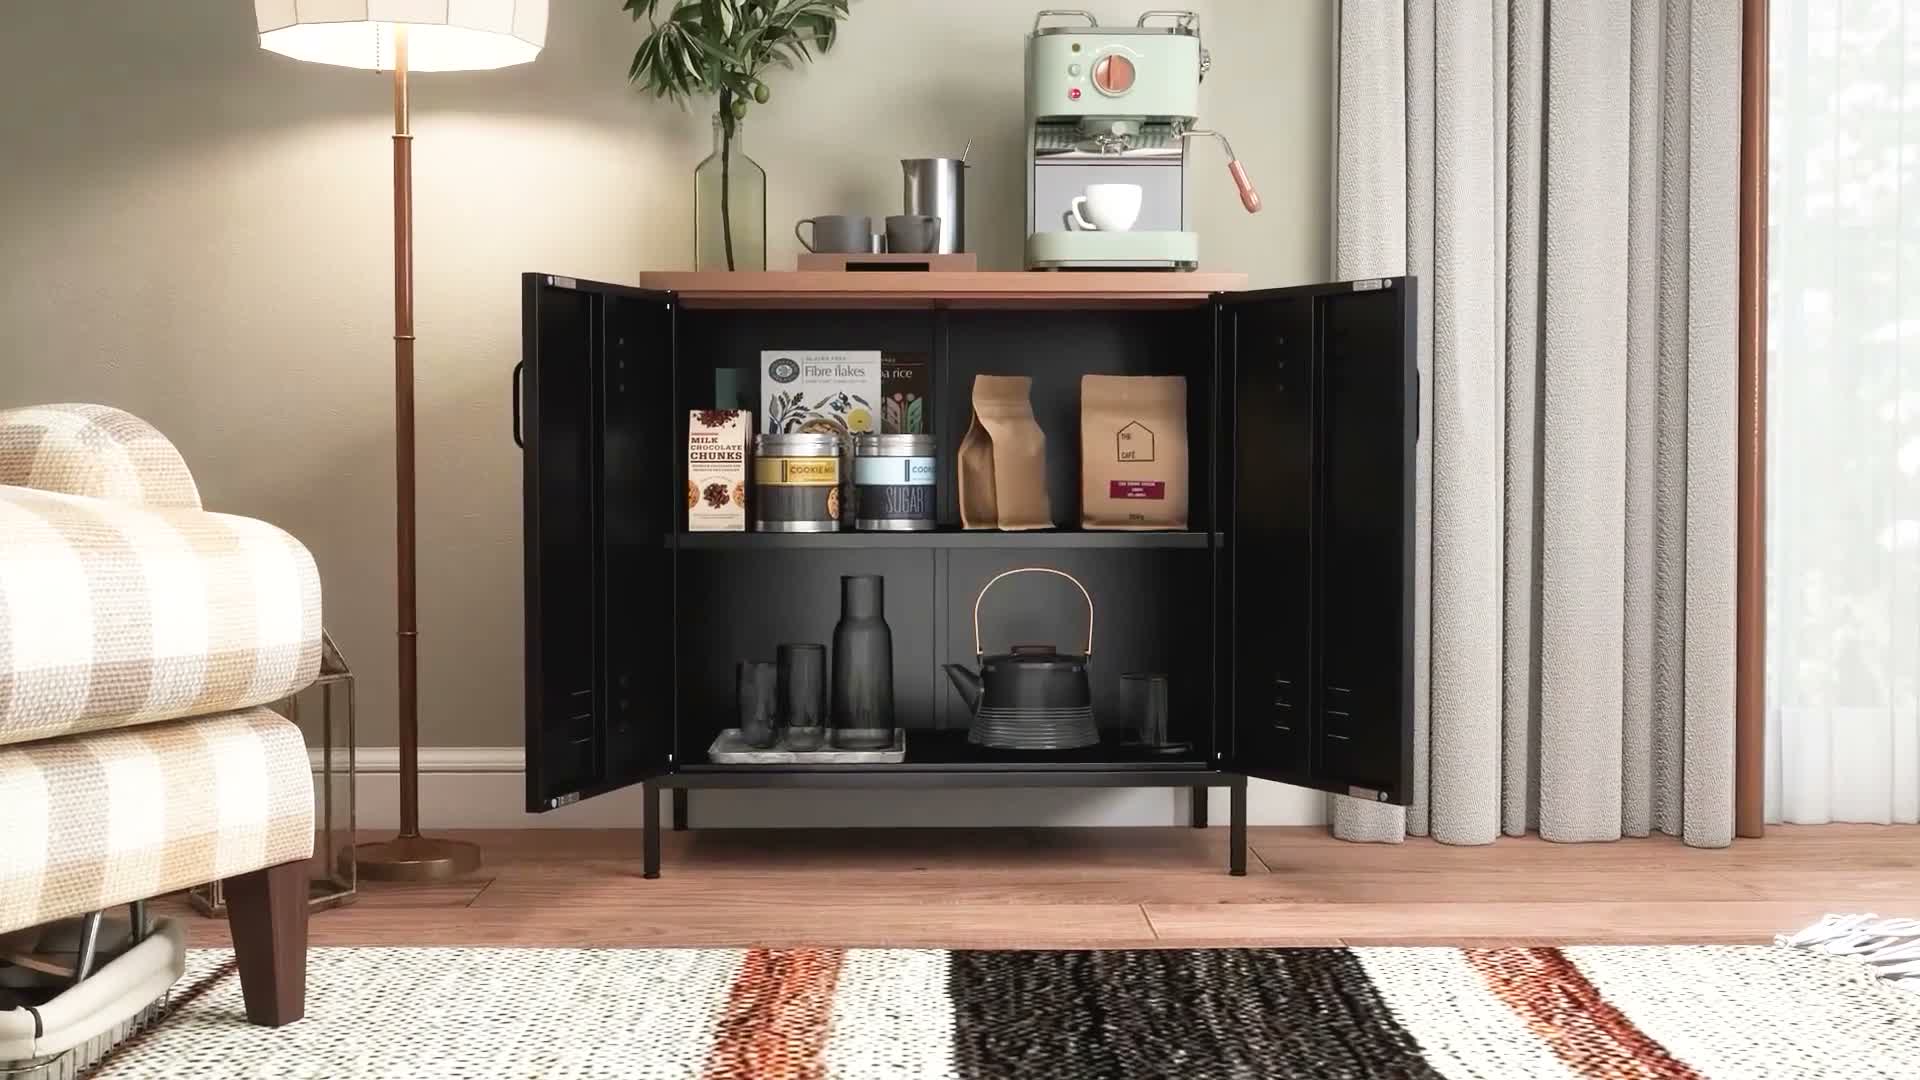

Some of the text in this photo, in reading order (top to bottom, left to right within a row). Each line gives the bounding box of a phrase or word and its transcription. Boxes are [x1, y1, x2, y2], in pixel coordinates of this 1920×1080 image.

[804, 364, 832, 377] Fibre
[834, 364, 866, 377] flakes
[893, 367, 913, 378] rice
[690, 451, 743, 460] CHUNKS
[790, 465, 824, 474] COOKIE
[886, 486, 925, 513] SUGAR
